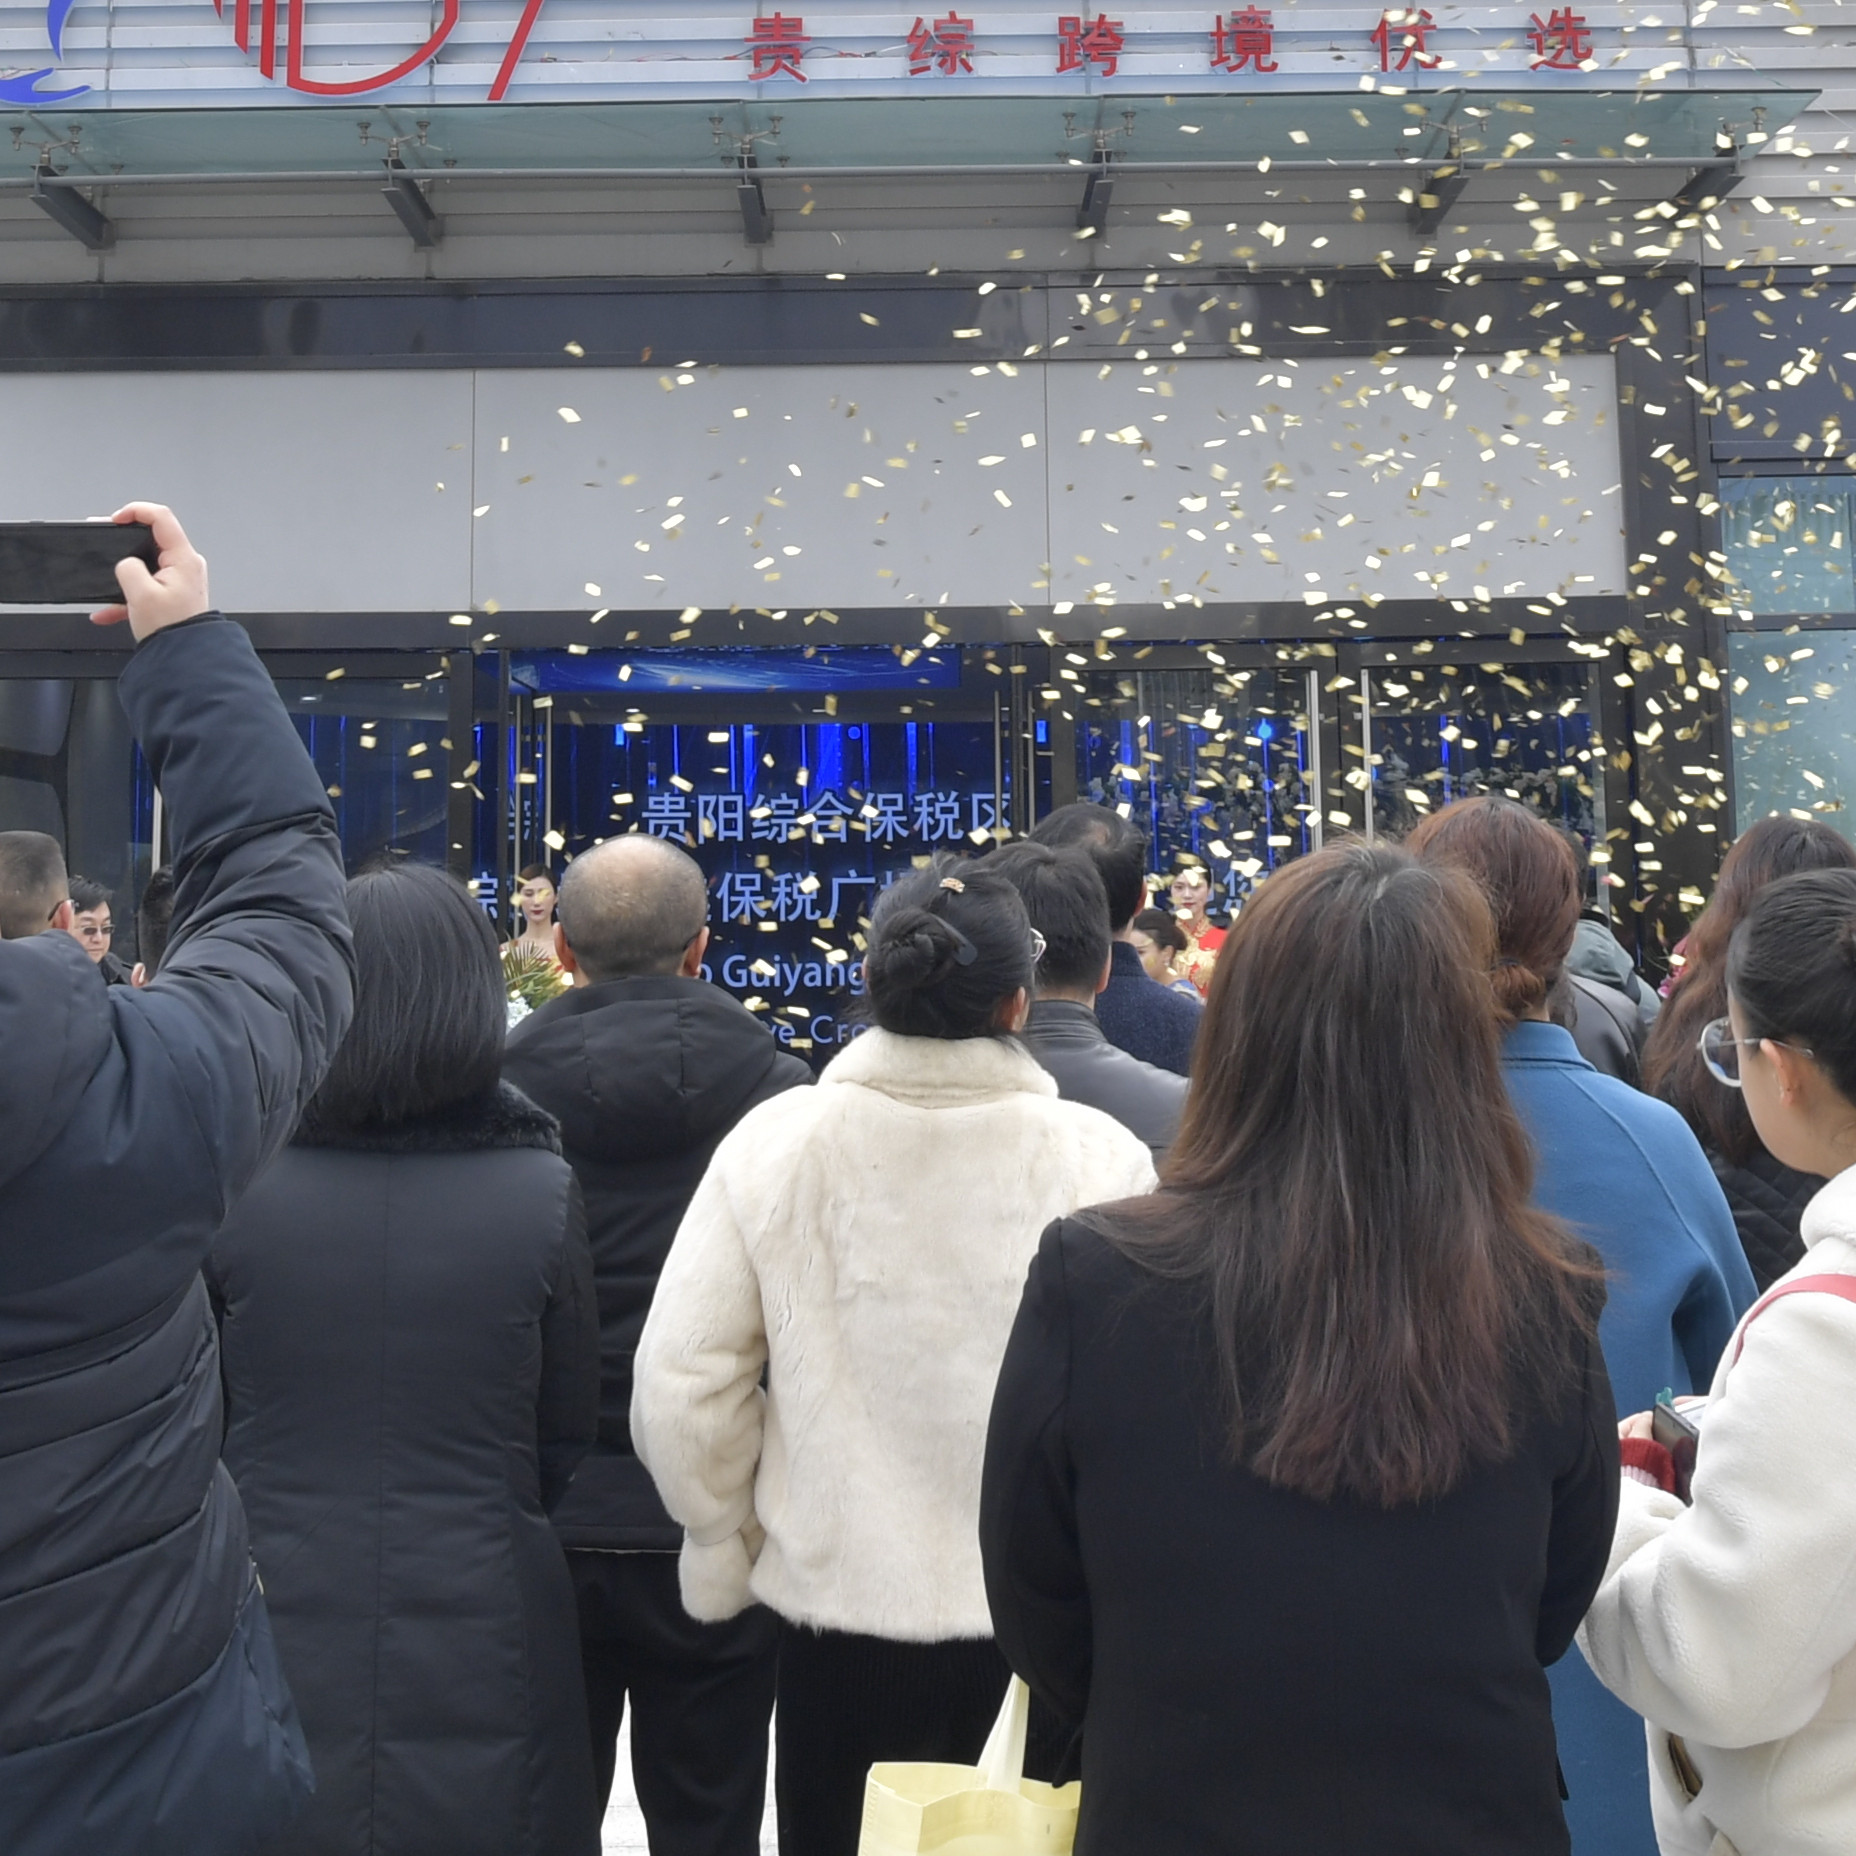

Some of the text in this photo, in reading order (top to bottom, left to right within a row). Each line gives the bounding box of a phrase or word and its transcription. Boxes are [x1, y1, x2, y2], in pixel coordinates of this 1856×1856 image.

[744, 4, 1598, 84] 贵综跨境优选
[641, 791, 1012, 844] 贵阳综合保税区
[716, 869, 908, 923] 保税广
